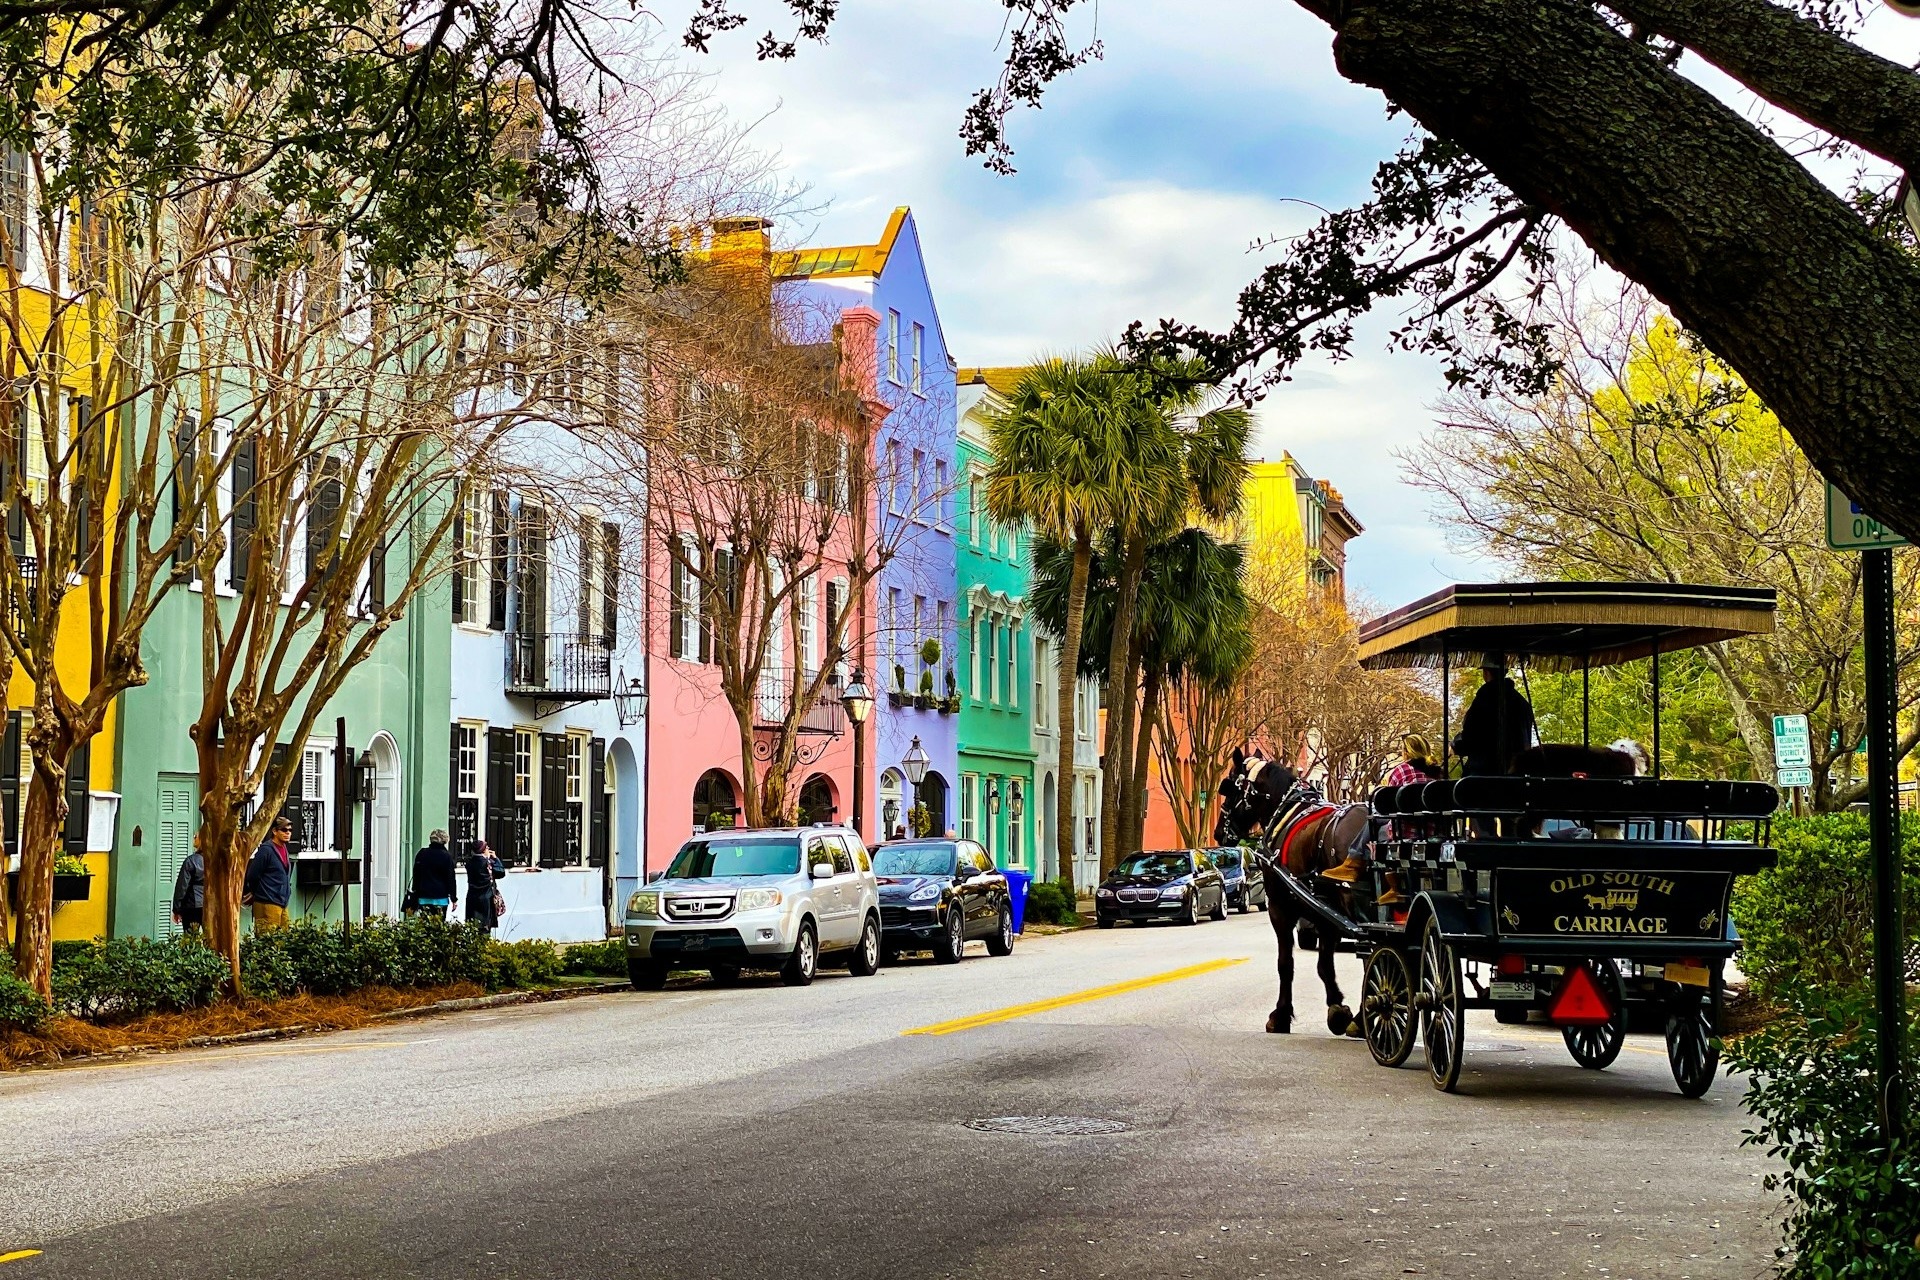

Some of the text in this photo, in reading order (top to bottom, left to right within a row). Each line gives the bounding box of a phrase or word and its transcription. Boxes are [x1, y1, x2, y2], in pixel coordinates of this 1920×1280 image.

[1852, 518, 1889, 539] ONL
[1777, 720, 1782, 734] 1
[1785, 726, 1806, 734] PARKING
[1779, 749, 1800, 757] DISTRICT
[1550, 871, 1676, 896] OLD SOUTH
[1553, 915, 1668, 934] CARRIAGE
[1514, 981, 1534, 992] 338
